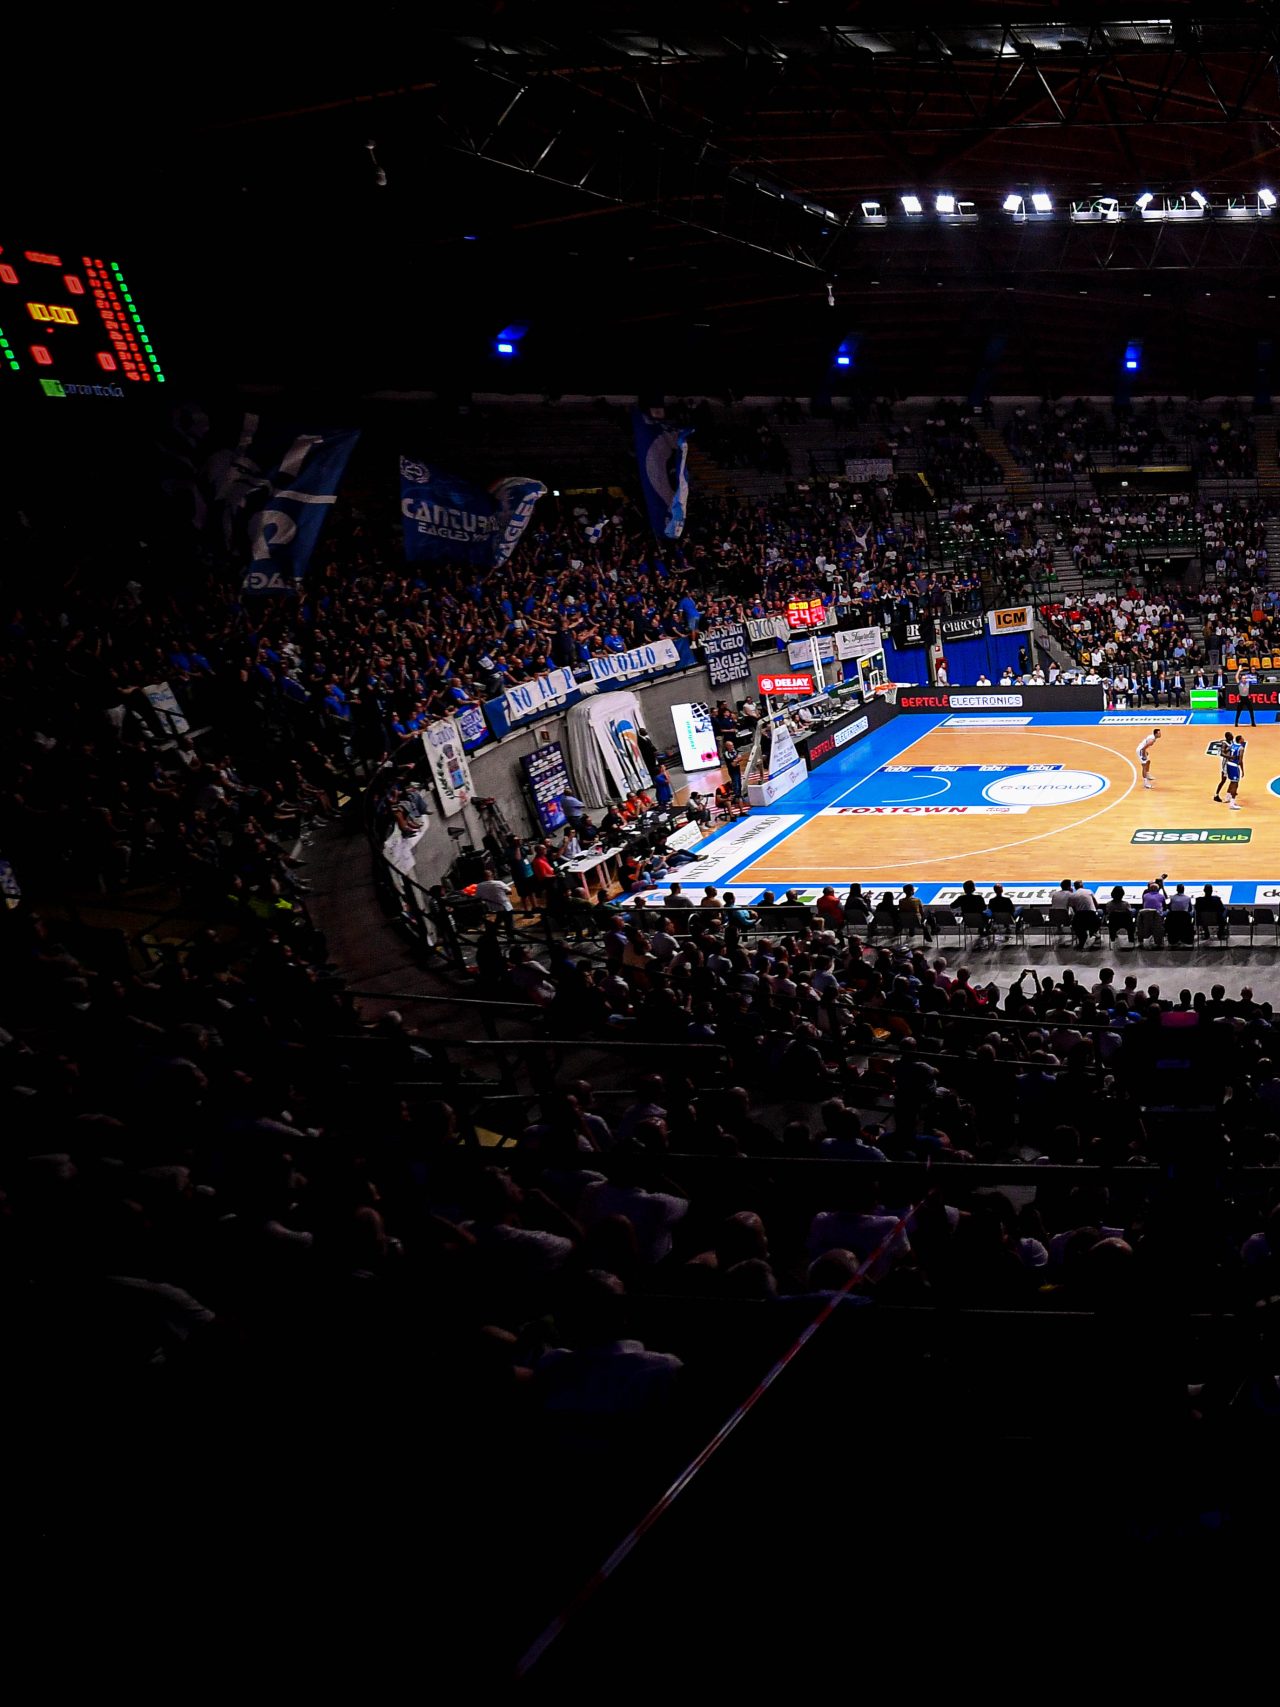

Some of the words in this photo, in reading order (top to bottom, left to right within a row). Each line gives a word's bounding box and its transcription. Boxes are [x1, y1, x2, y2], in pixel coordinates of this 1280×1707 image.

[64, 274, 85, 294] 0
[30, 345, 53, 364] 0
[97, 352, 117, 371] 0
[417, 520, 471, 542] EAGLES
[788, 609, 811, 625] 24
[996, 611, 1026, 626] ICM
[510, 687, 532, 713] NO
[951, 697, 1022, 706] ELECTRONICS
